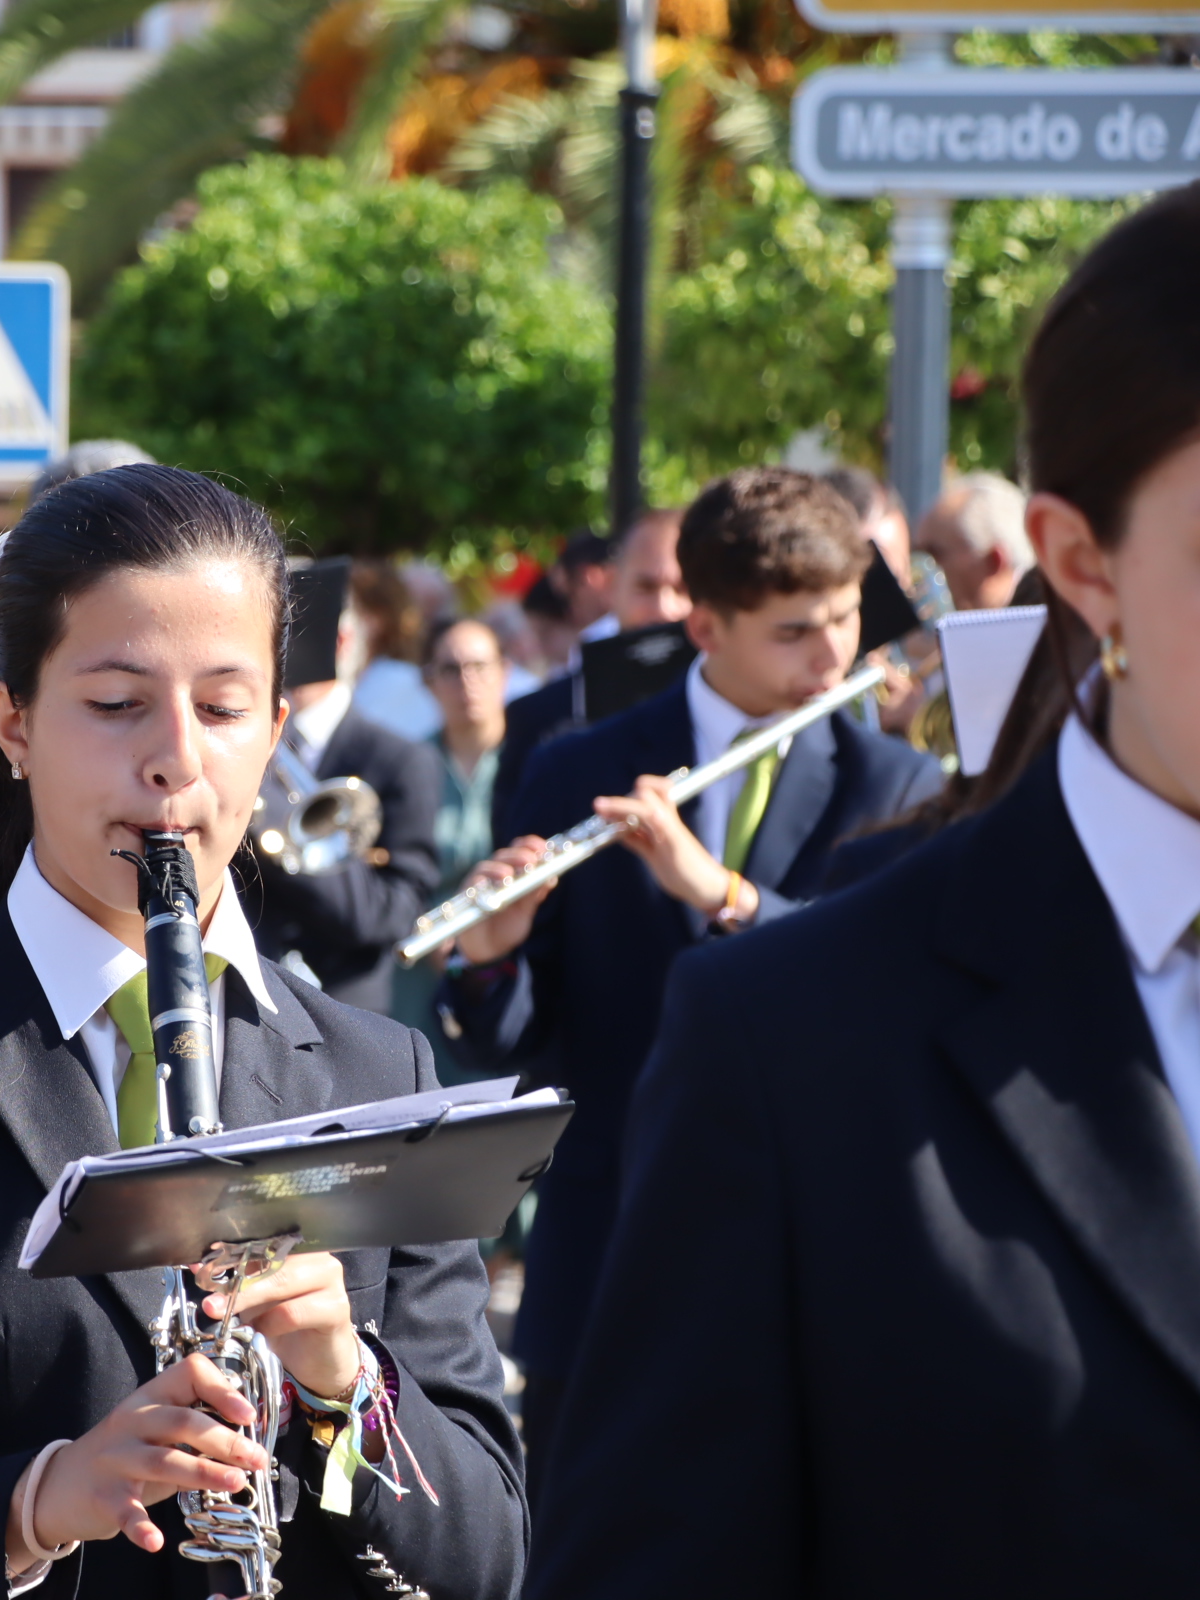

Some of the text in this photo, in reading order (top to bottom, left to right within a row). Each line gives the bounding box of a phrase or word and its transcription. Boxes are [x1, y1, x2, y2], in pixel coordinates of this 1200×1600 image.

[837, 103, 1081, 162] Mercado
[1095, 103, 1168, 162] de
[175, 900, 185, 908] 40
[327, 1165, 387, 1178] BANDA
